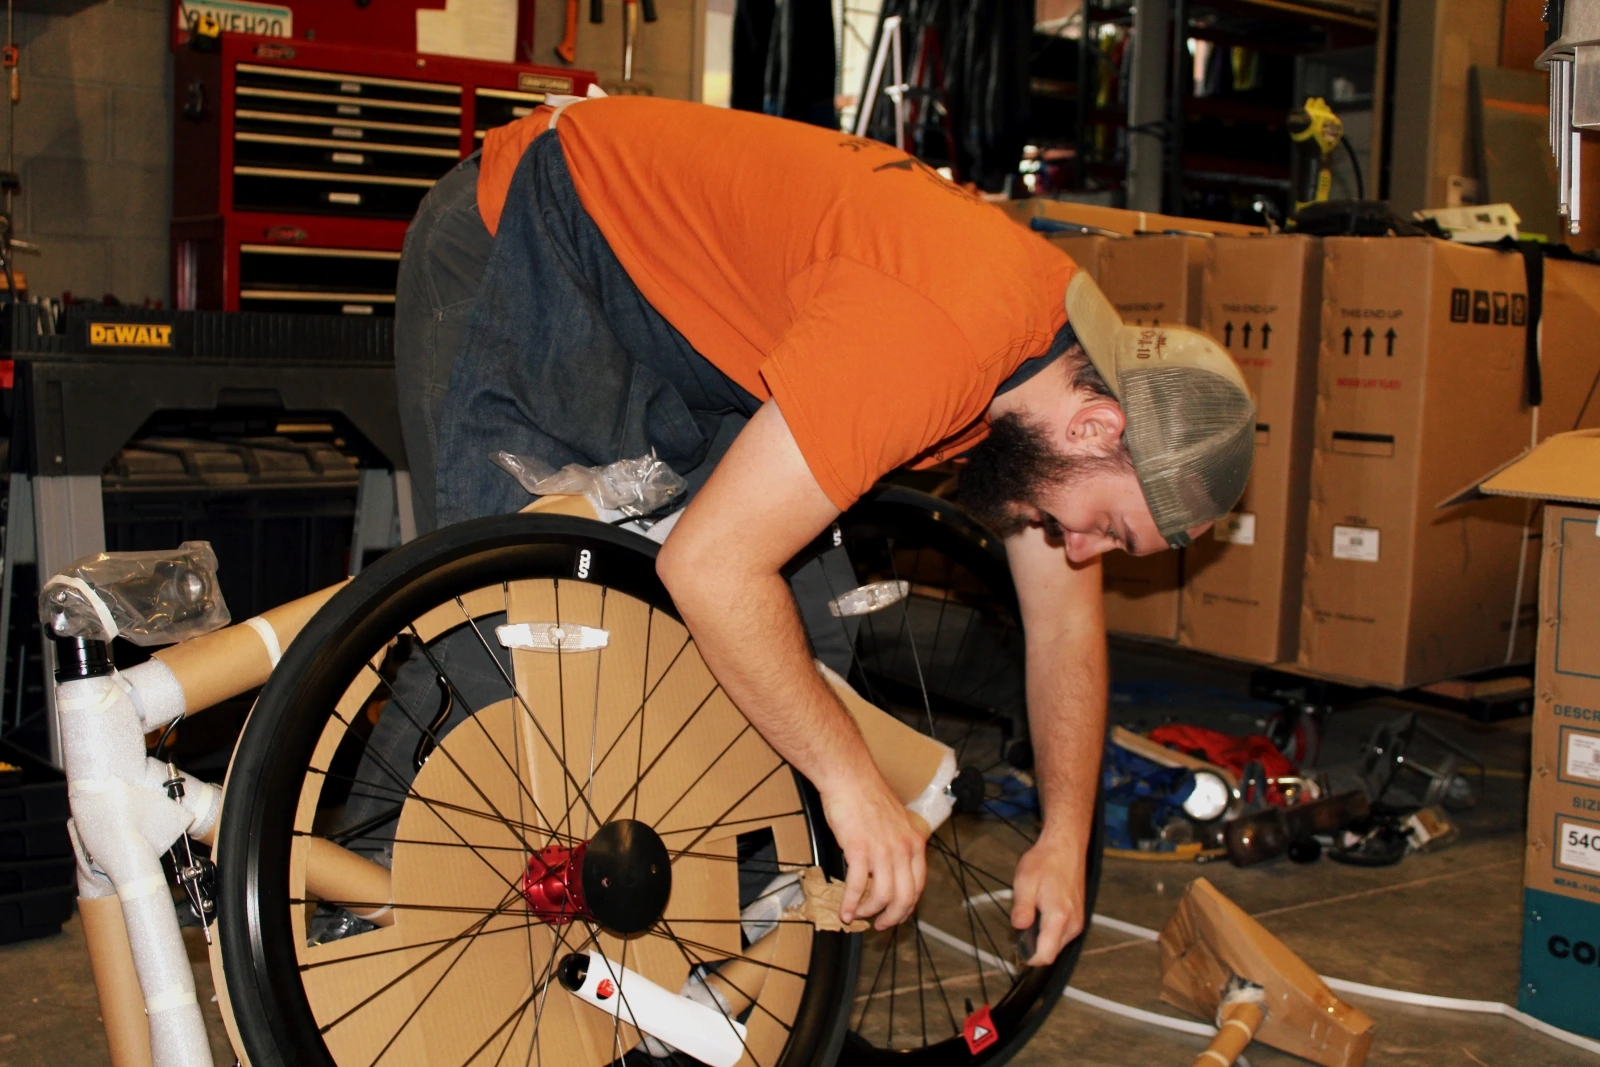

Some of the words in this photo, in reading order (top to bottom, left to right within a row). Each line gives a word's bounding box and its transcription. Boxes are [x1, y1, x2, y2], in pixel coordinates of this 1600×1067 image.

[1341, 308, 1361, 318] THIS
[1363, 309, 1386, 319] END
[1387, 310, 1403, 319] UP
[1573, 796, 1600, 812] SIZ
[1547, 934, 1600, 968] CO
